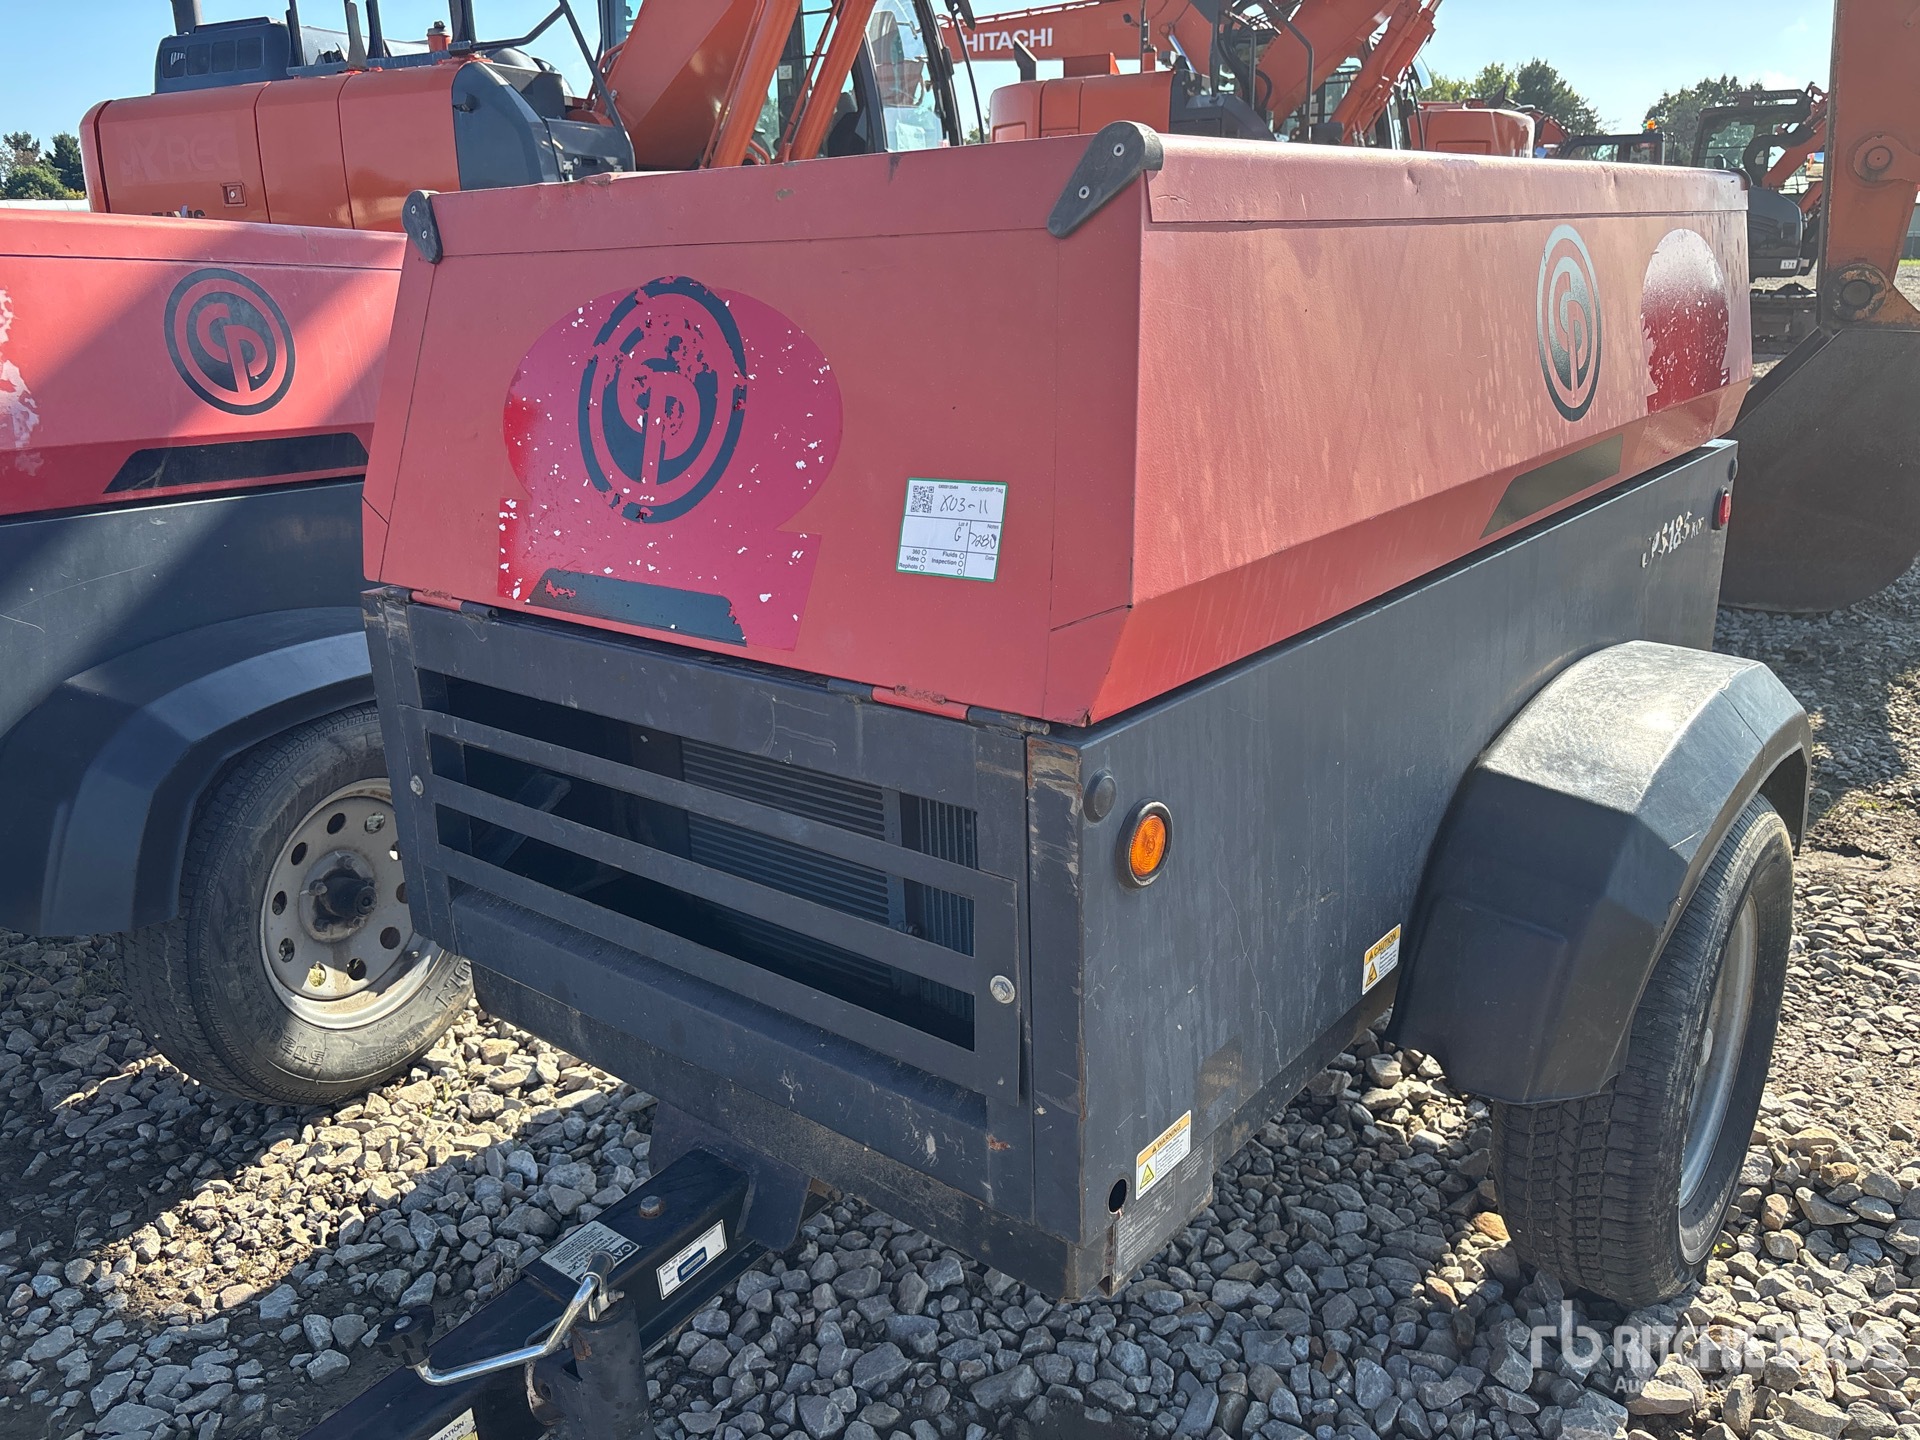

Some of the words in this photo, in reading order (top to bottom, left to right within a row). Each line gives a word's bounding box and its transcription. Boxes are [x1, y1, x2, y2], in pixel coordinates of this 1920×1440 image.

[963, 27, 1053, 52] HITACHI
[942, 551, 958, 559] Fluids
[931, 558, 957, 566] Inspection
